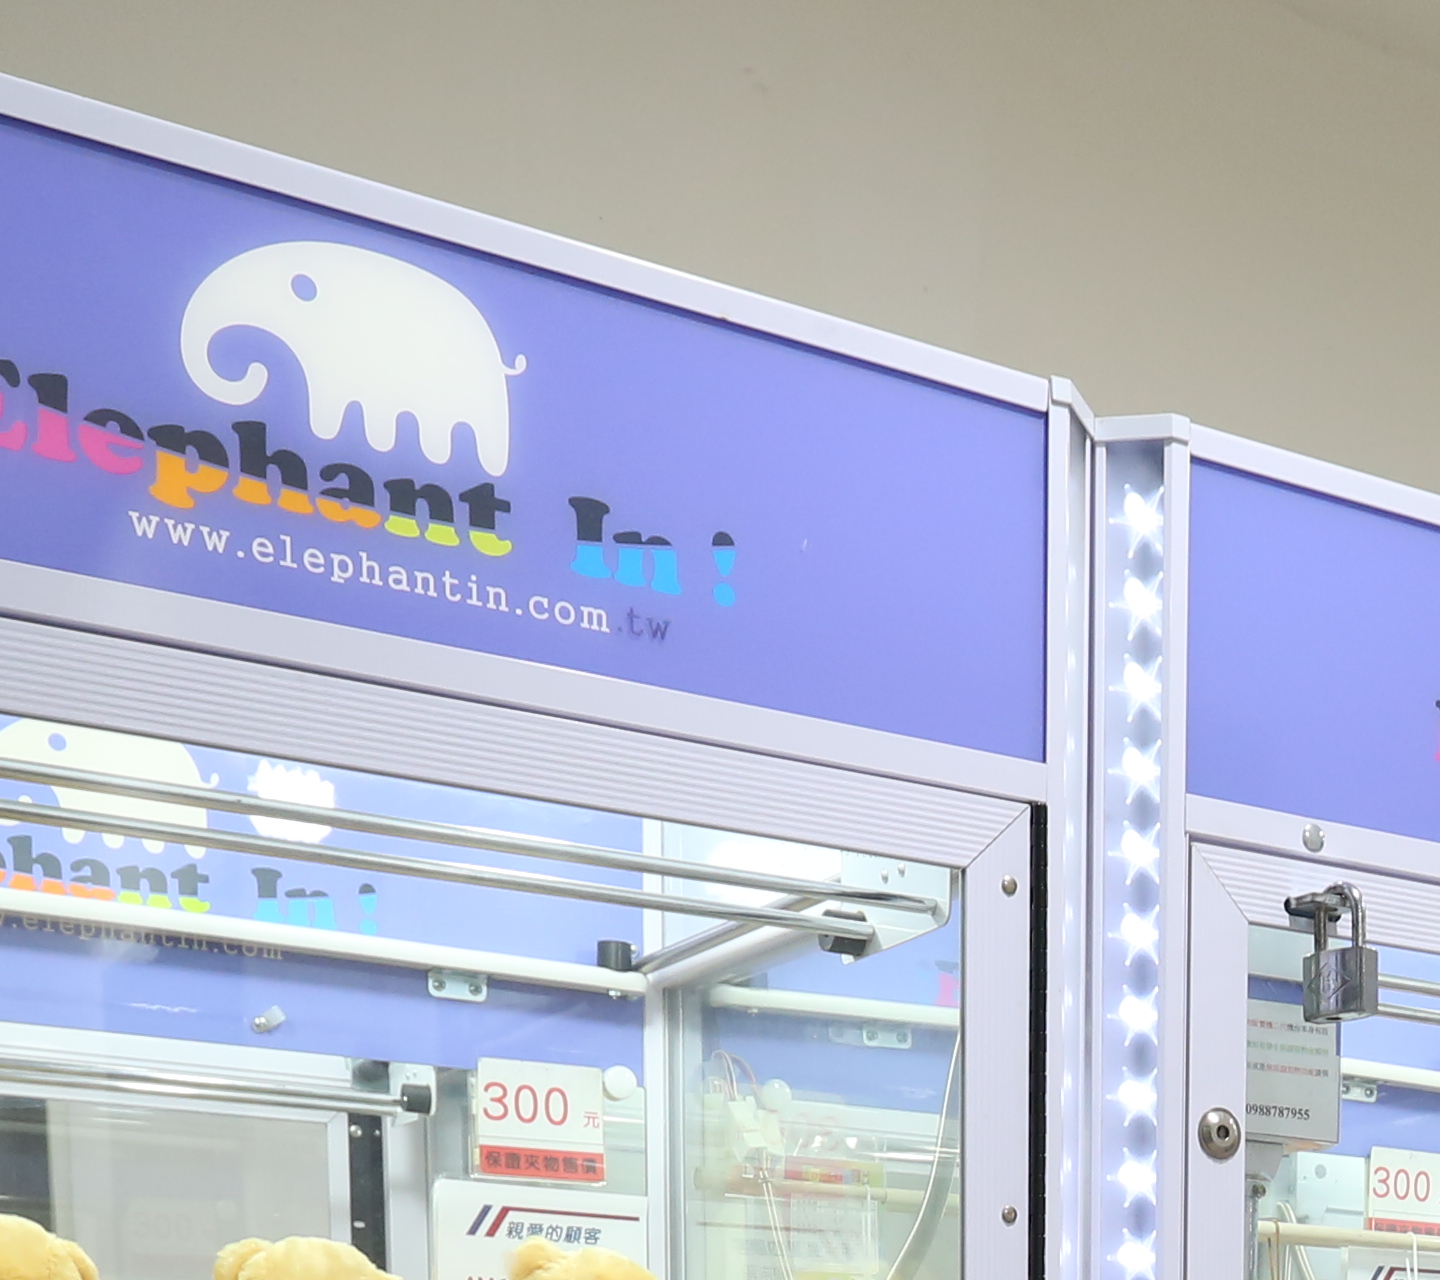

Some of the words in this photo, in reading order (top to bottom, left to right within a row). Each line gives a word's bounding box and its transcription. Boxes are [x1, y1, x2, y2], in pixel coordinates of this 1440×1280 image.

[482, 1081, 569, 1126] 300
[583, 1110, 600, 1129] 元
[1372, 1166, 1431, 1202] 300
[505, 1220, 602, 1245] 親愛的顧客
